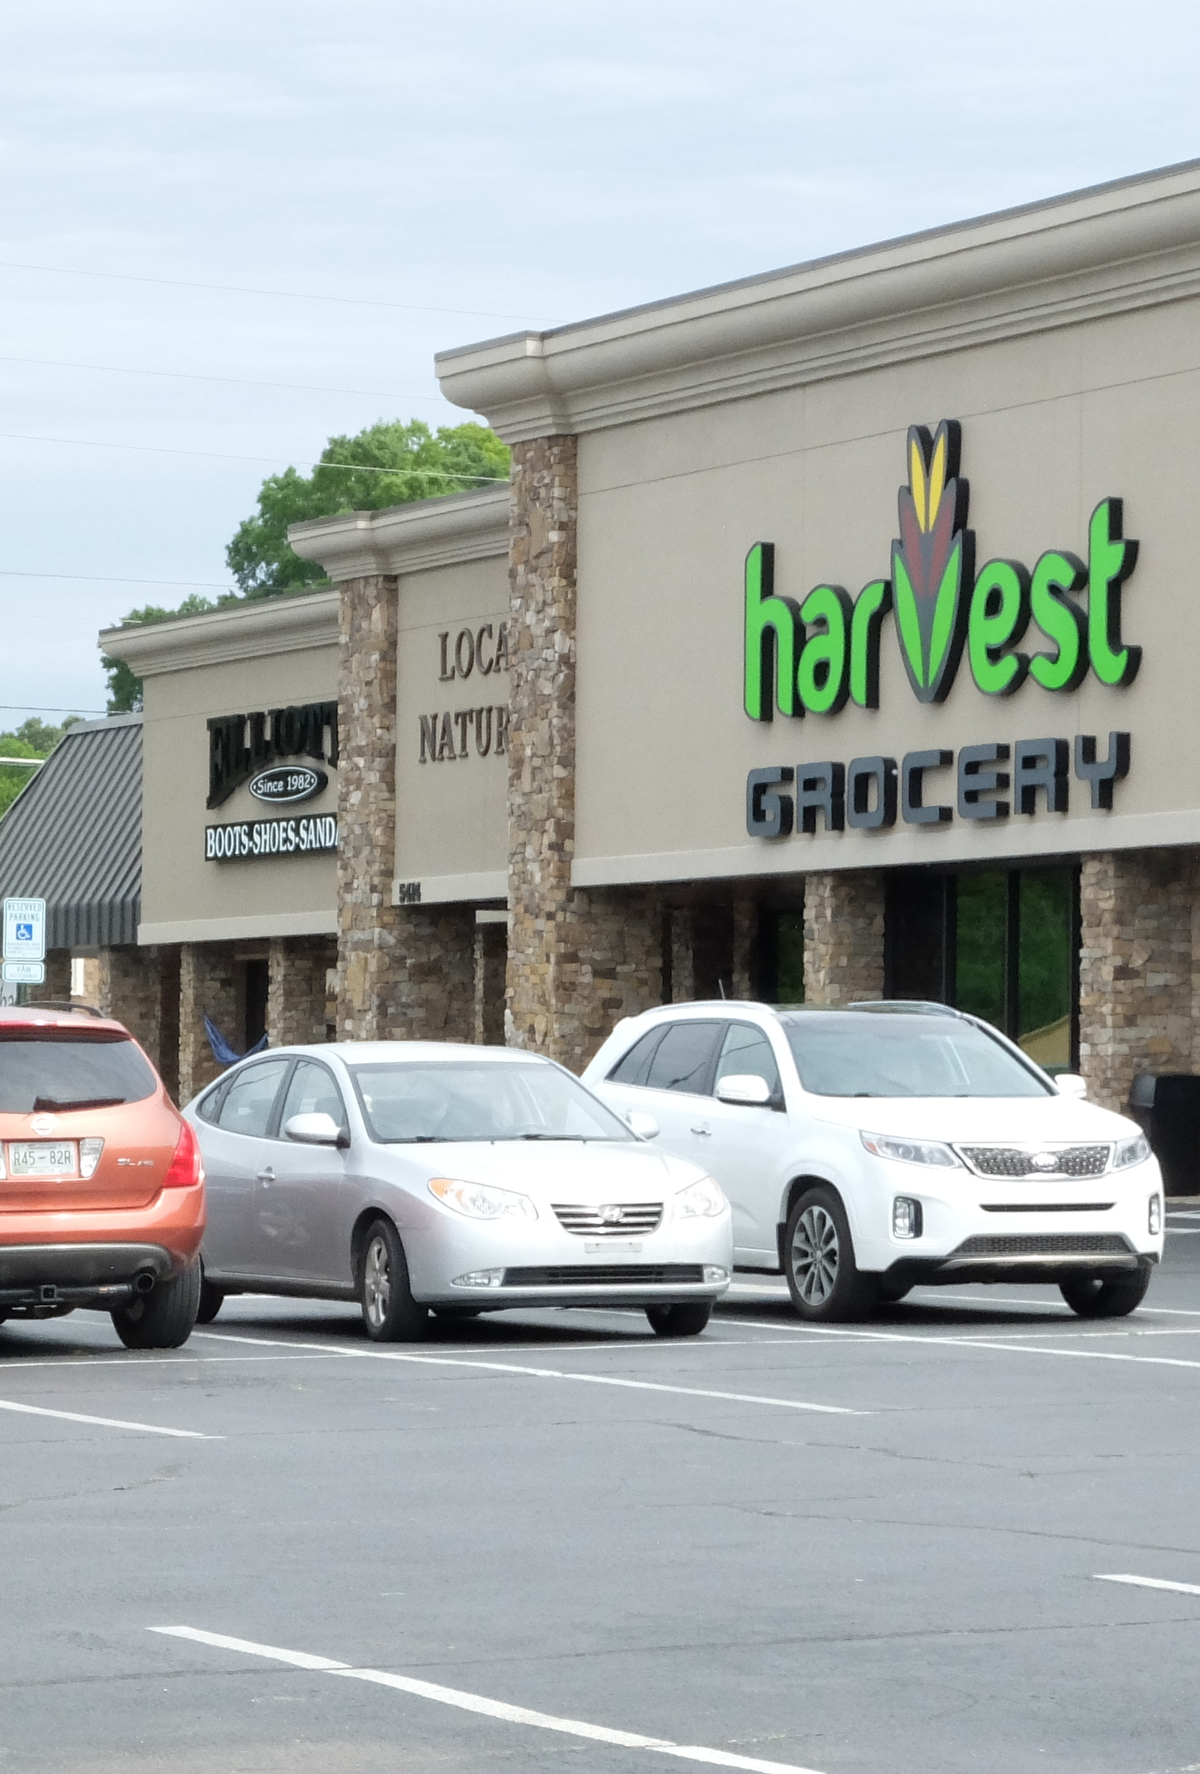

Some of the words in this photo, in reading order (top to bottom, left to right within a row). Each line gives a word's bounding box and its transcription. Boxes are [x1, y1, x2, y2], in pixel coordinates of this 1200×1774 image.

[744, 419, 1142, 722] harvest
[257, 779, 284, 795] Since
[286, 774, 311, 791] 1982
[746, 731, 1131, 837] GROCERY
[7, 902, 42, 912] RESERVED
[9, 912, 40, 922] PARKING
[16, 965, 32, 973] VAN
